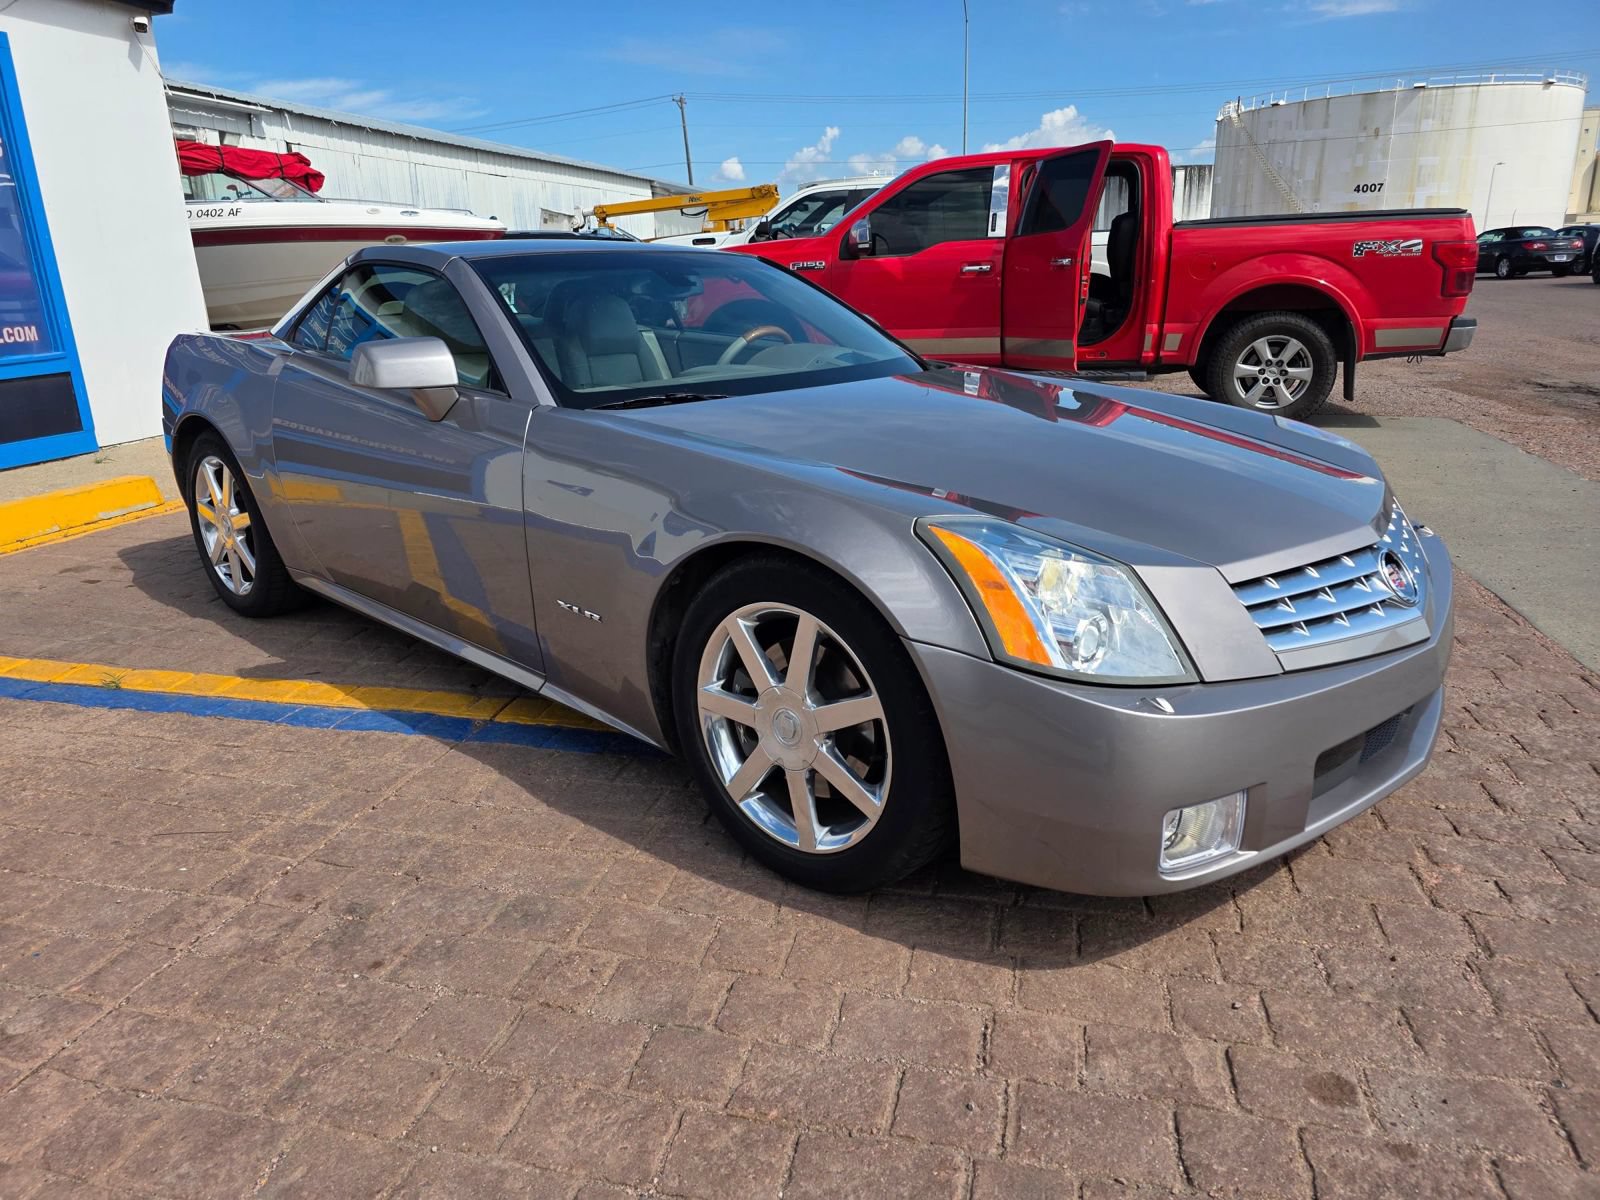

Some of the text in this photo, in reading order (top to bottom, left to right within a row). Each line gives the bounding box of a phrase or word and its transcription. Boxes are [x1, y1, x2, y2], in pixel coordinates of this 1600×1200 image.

[1353, 182, 1385, 194] 4007
[196, 208, 224, 218] 0402
[227, 207, 242, 216] AF
[1353, 239, 1423, 257] FX4
[556, 598, 603, 624] XLR
